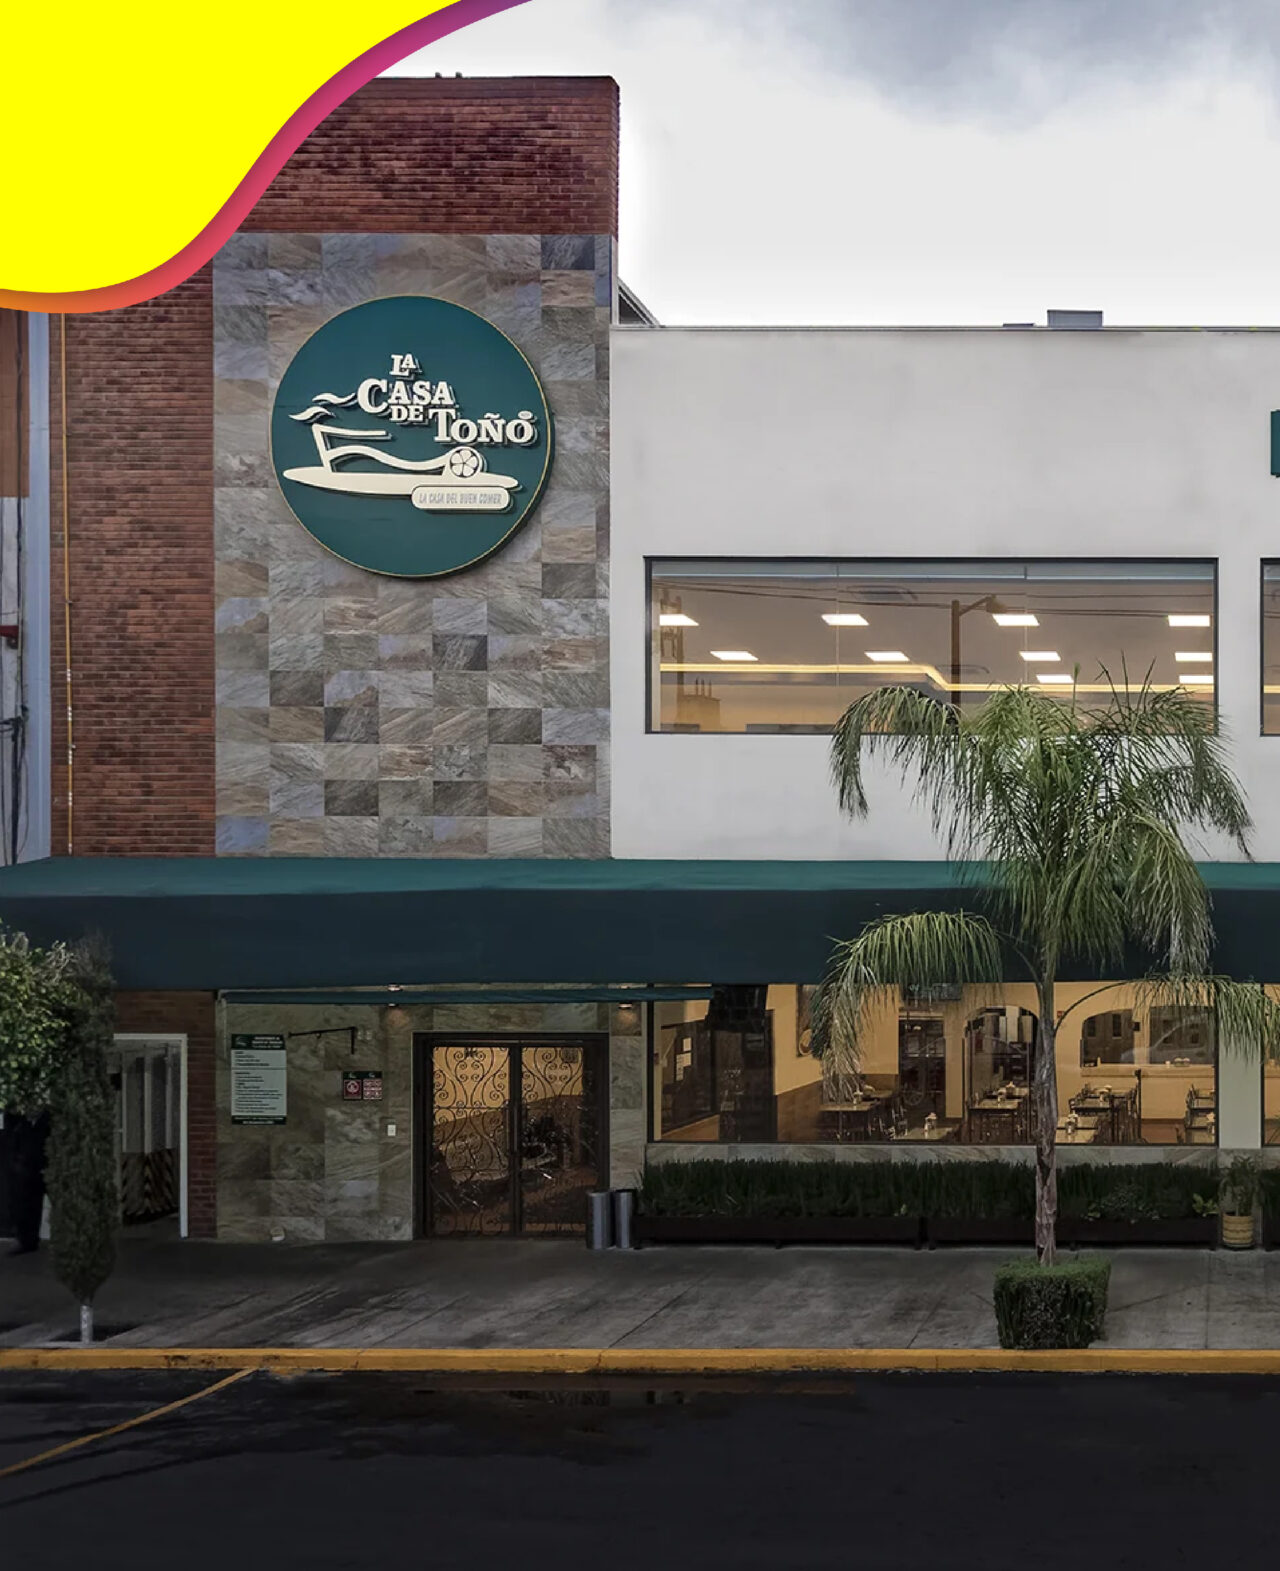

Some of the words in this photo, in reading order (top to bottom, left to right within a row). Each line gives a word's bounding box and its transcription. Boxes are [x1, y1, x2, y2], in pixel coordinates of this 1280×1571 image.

[389, 353, 417, 376] LA
[357, 378, 455, 413] CASA
[389, 404, 424, 421] DE
[428, 407, 534, 443] TOÑO
